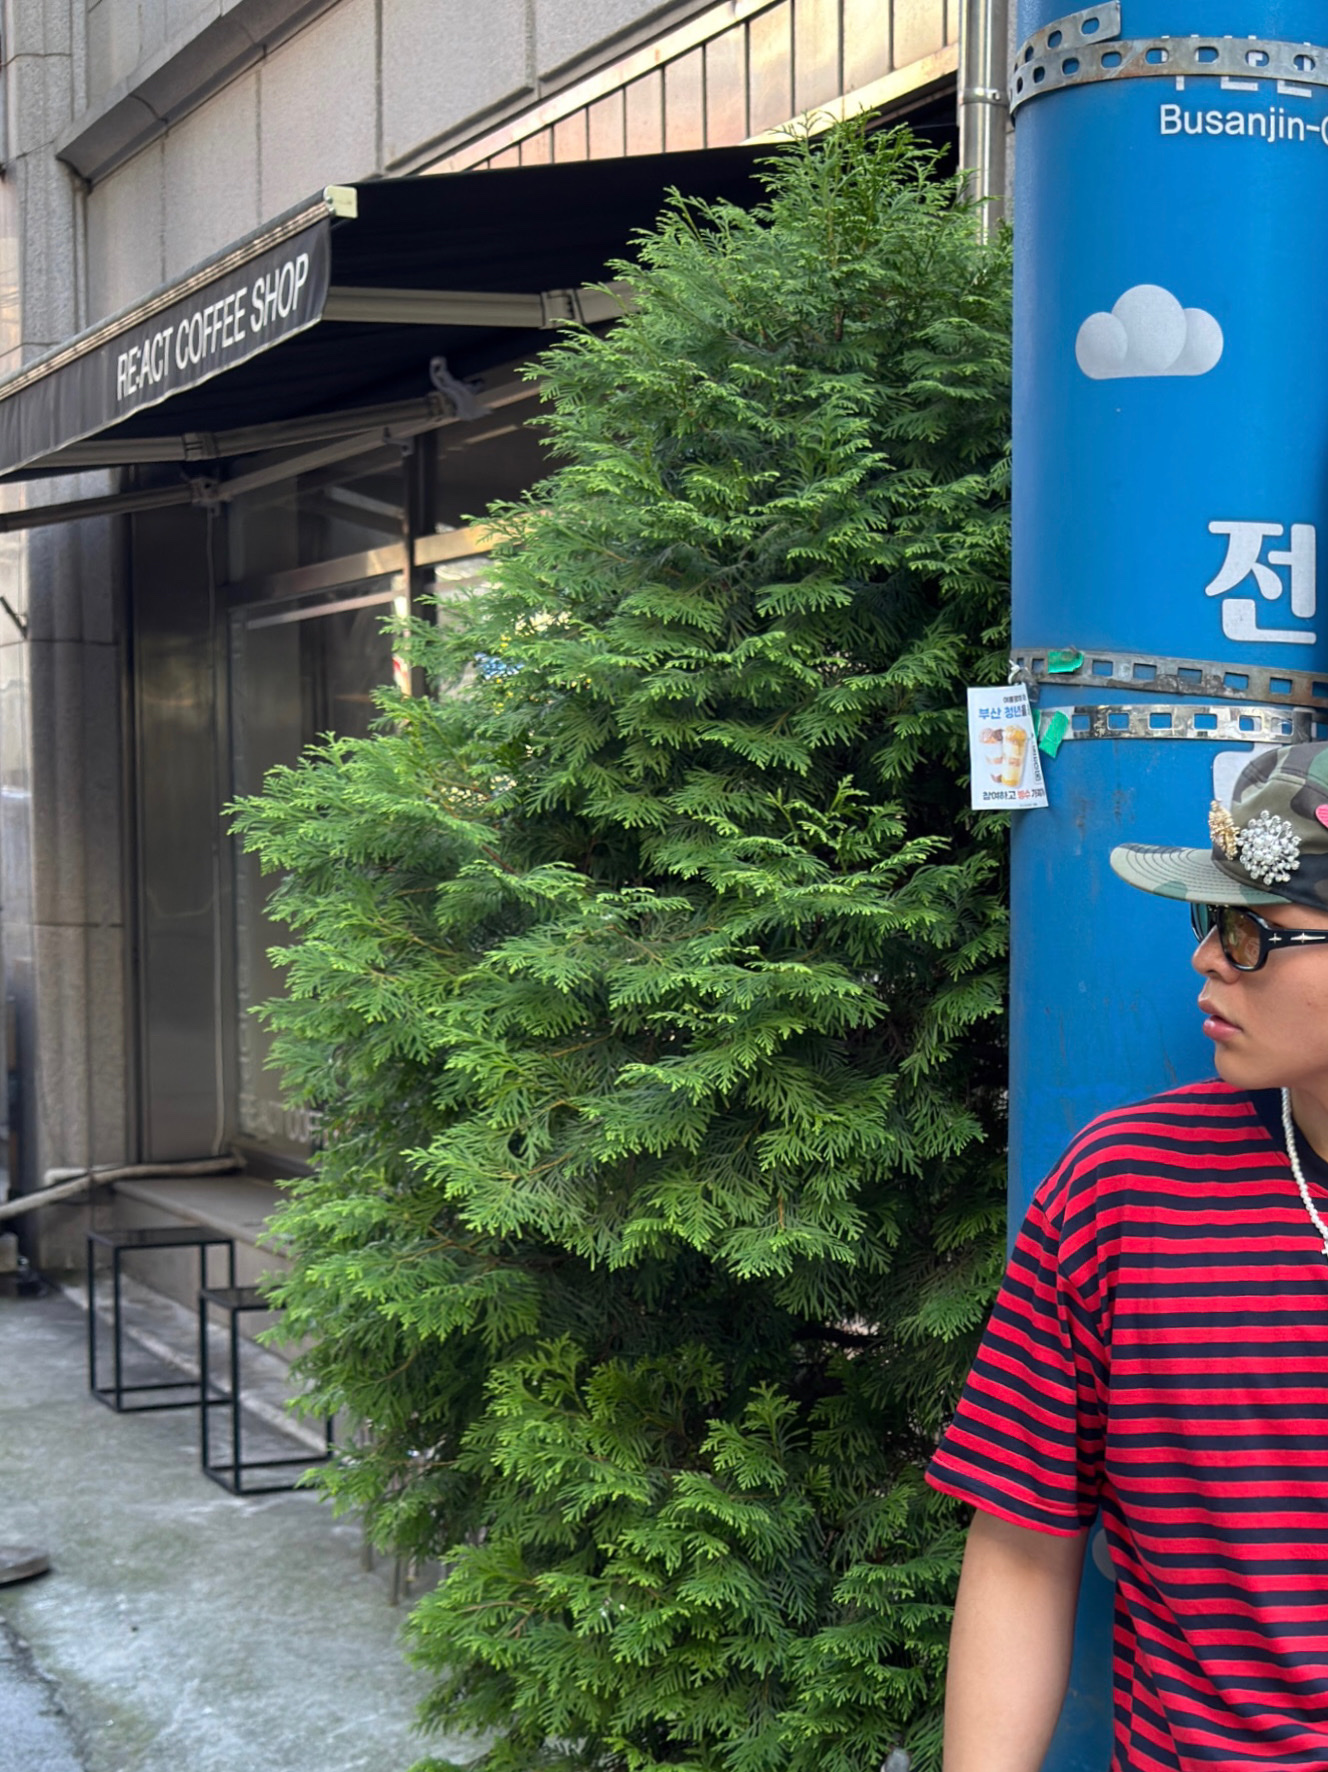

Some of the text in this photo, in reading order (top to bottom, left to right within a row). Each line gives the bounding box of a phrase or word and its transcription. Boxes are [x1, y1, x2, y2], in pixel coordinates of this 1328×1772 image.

[117, 252, 310, 401] RE:ACT COFFEE SHOP
[978, 706, 1002, 720] 부산
